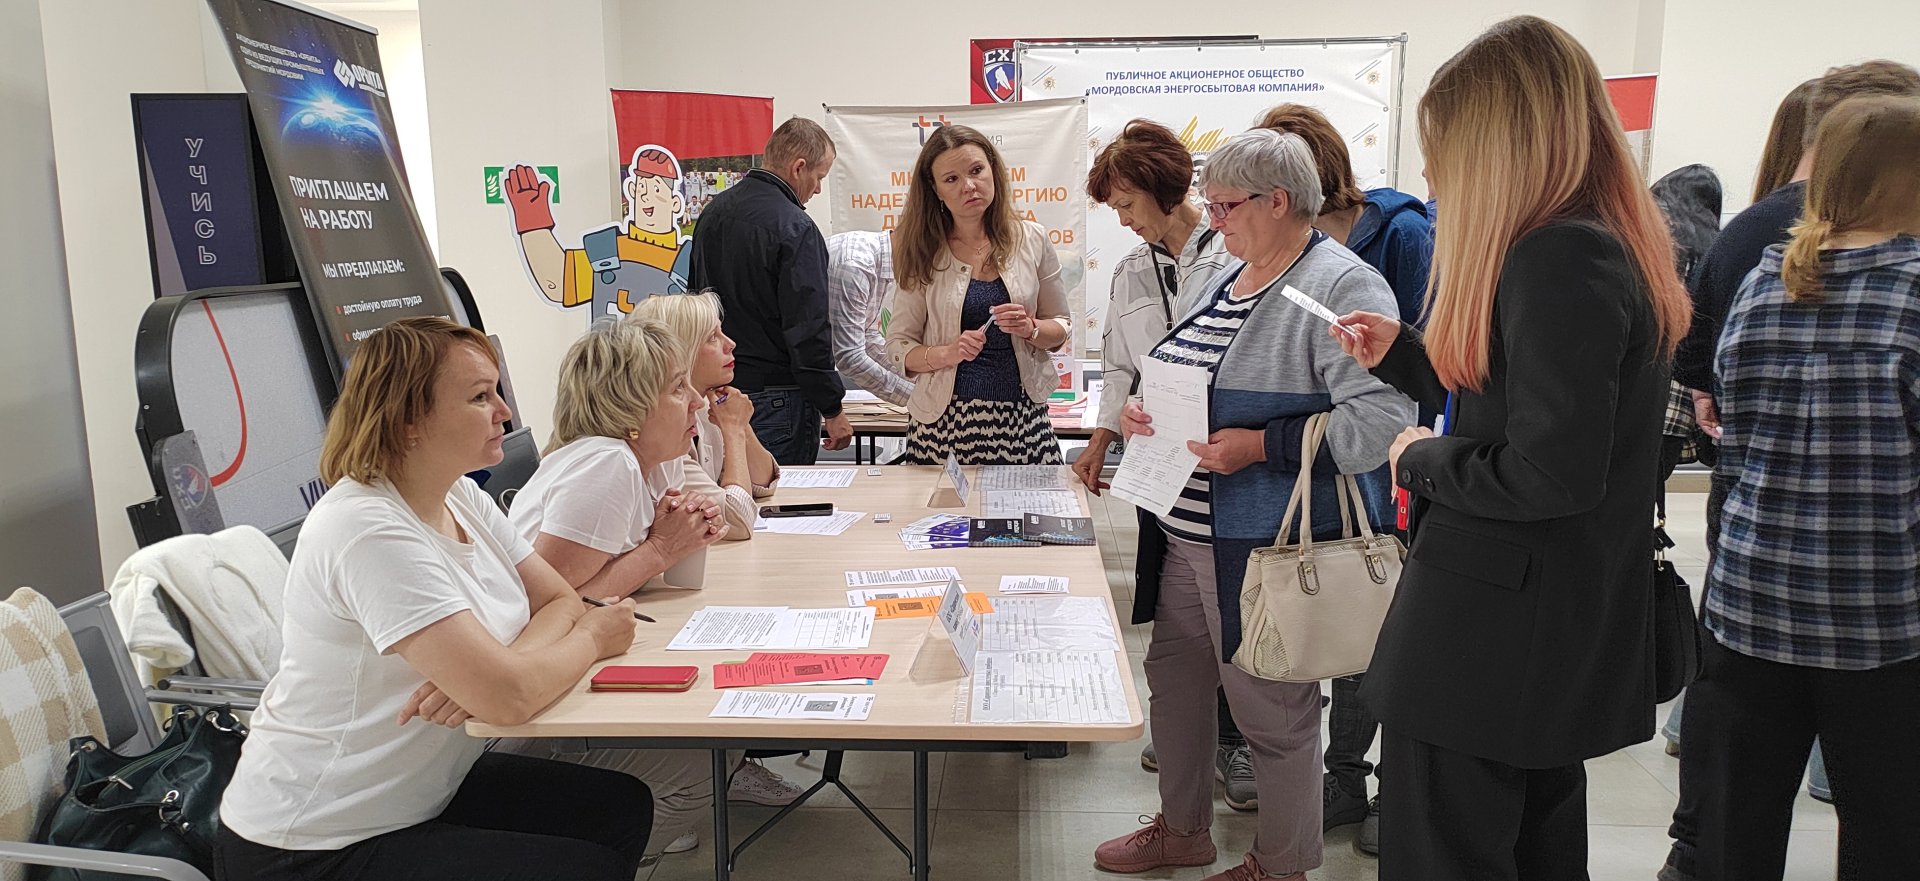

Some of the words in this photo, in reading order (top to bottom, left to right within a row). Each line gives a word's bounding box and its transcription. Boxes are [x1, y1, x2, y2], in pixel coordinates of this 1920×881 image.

[350, 63, 384, 91] ОРБИТА
[1105, 70, 1167, 81] ПУБЛИЧНОЕ
[1169, 69, 1245, 81] АКЦИОНЕРНОЕ
[1247, 68, 1305, 80] ОБЩЕСТВО
[1085, 85, 1161, 96] «МОРДОВСКАЯ
[1163, 83, 1256, 94] ЭНЕРГОСБЫТОВАЯ
[1258, 82, 1325, 94] КОМПАНИЯ»
[288, 175, 390, 201] ПРИГЛАШАЕМ
[184, 138, 217, 265] УЧИСЬ
[300, 207, 321, 230] НА
[319, 209, 374, 230] РАБОТУ
[321, 262, 338, 279] МЫ
[337, 259, 406, 279] ПРЕДЛАГАЕМ:
[343, 300, 381, 316] достойную
[380, 297, 403, 309] оплату
[402, 295, 423, 307] труда
